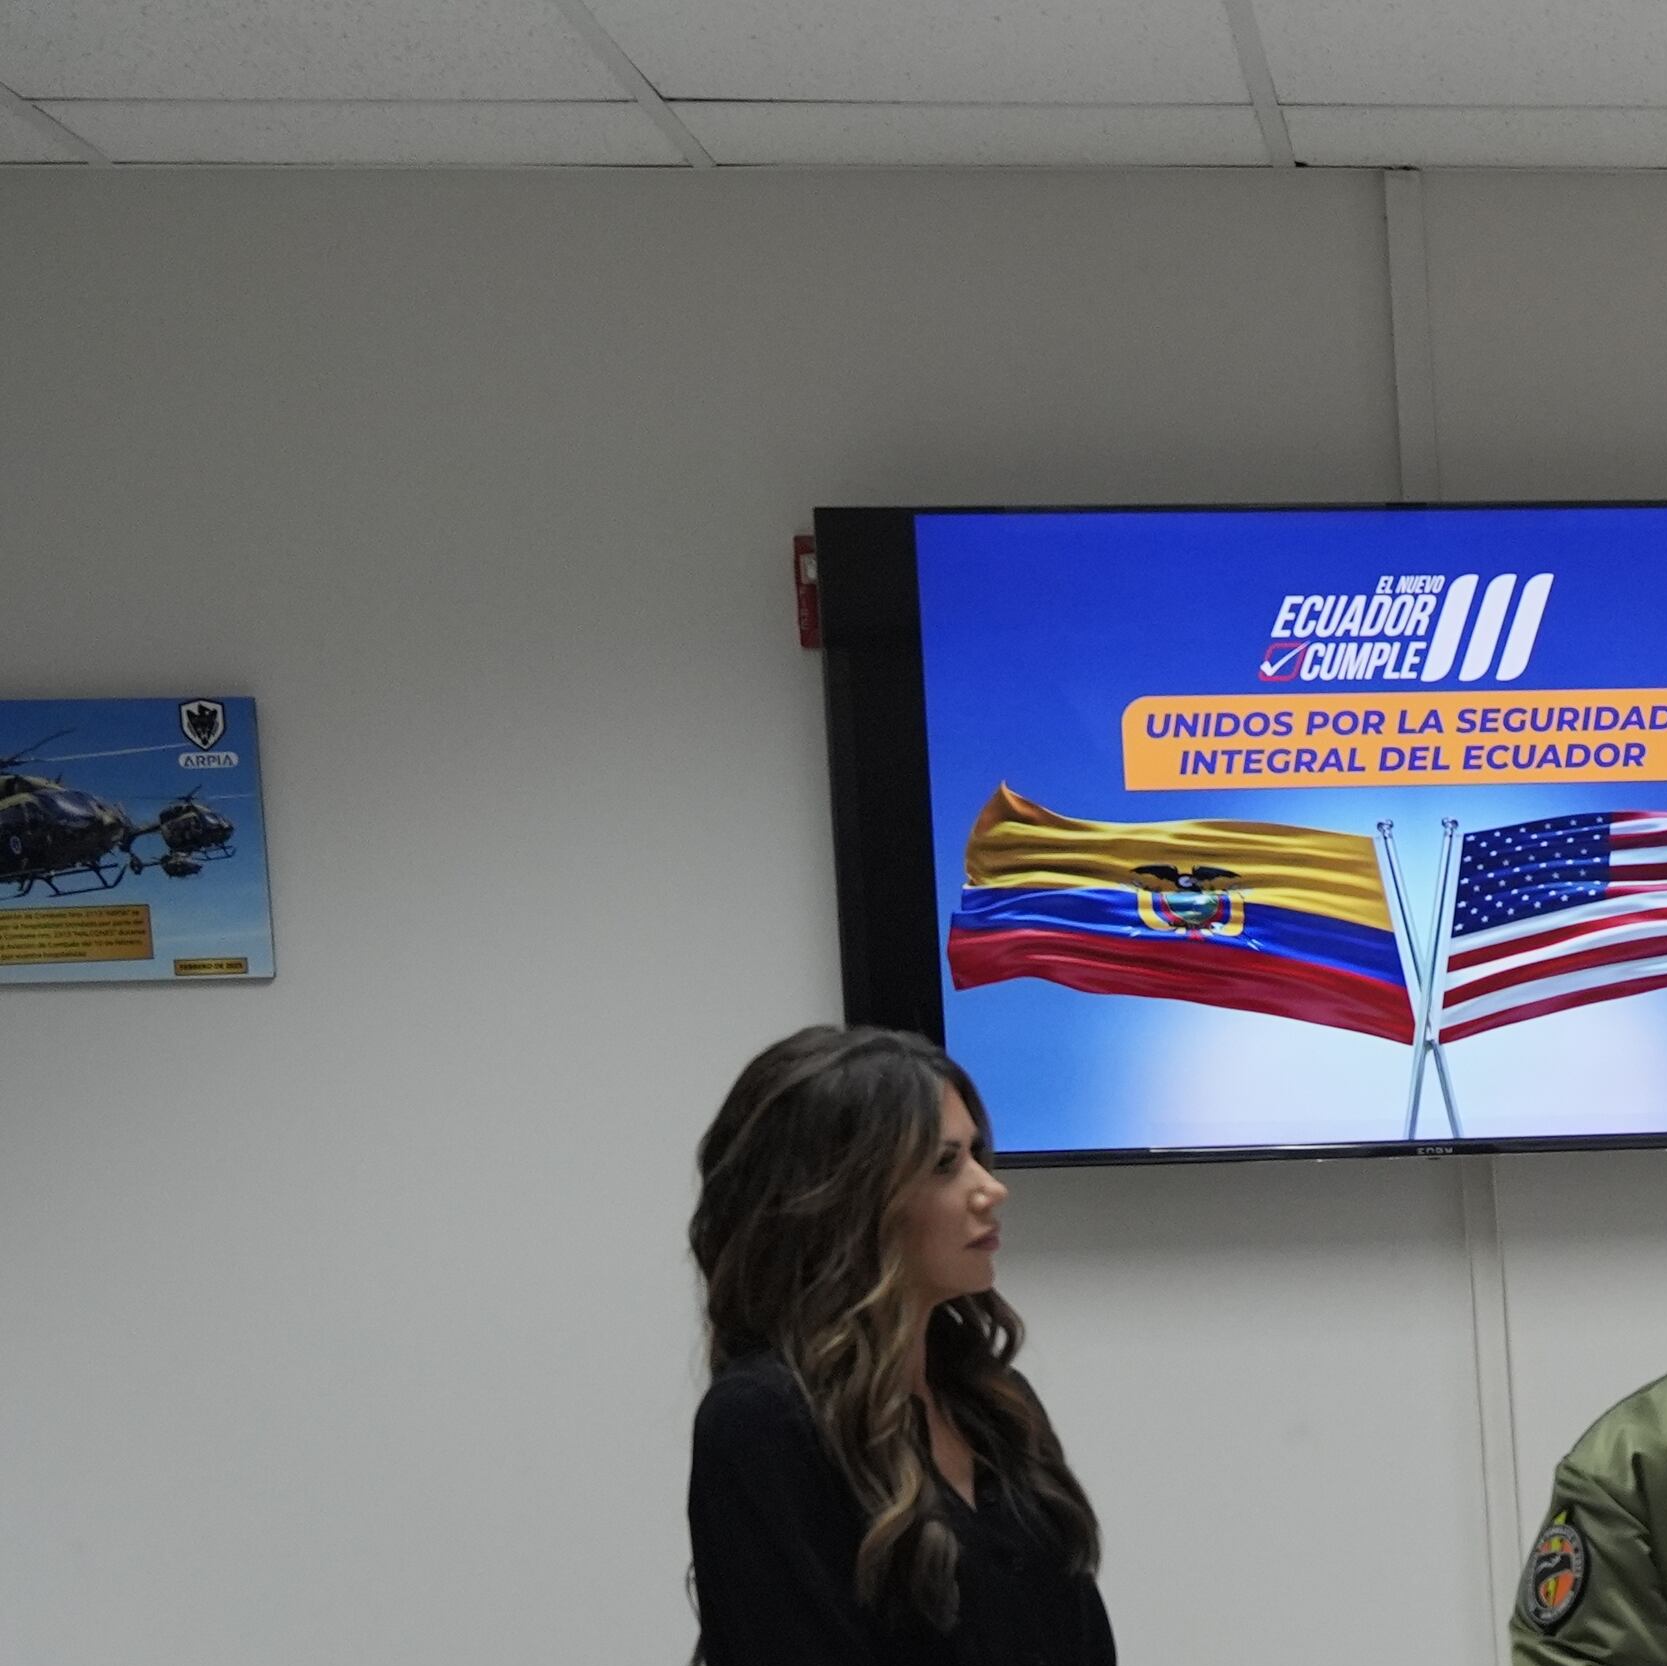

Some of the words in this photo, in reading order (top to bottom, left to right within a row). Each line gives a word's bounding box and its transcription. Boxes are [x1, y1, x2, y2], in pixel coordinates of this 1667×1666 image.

[1376, 575, 1395, 594] EL
[1397, 575, 1446, 594] NUEVO
[1270, 594, 1438, 638] ECUADOR
[1300, 641, 1427, 681] CUMPLE
[1144, 711, 1294, 739] UNIDOS
[1305, 709, 1387, 736] POR
[1396, 708, 1446, 735] LA
[184, 754, 233, 767] ARPIA
[1178, 746, 1367, 776] INTEGRAL
[1379, 745, 1451, 772] DEL
[1462, 741, 1648, 771] ECUADOR
